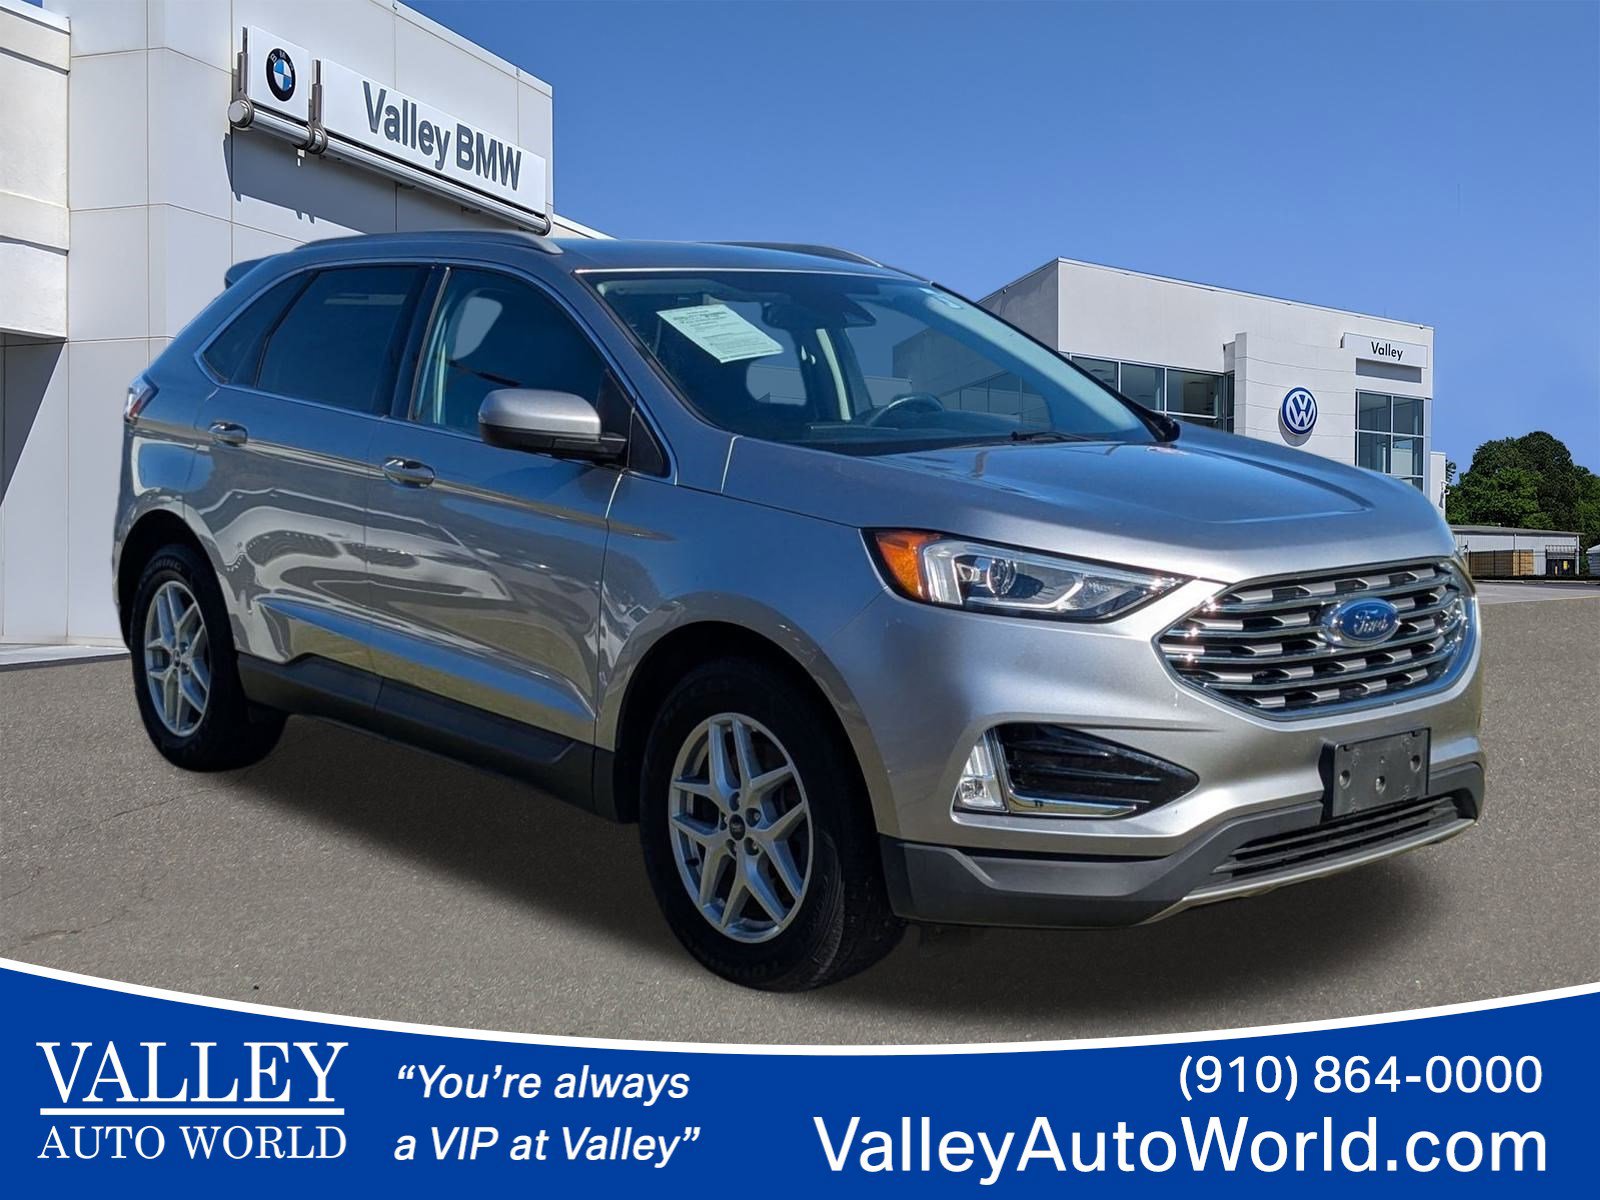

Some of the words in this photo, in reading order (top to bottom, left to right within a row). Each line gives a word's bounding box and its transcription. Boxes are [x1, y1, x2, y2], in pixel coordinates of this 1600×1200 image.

[362, 81, 450, 170] Valley
[456, 123, 522, 191] BMW
[1371, 341, 1403, 361] Valley
[1353, 609, 1389, 636] Ford
